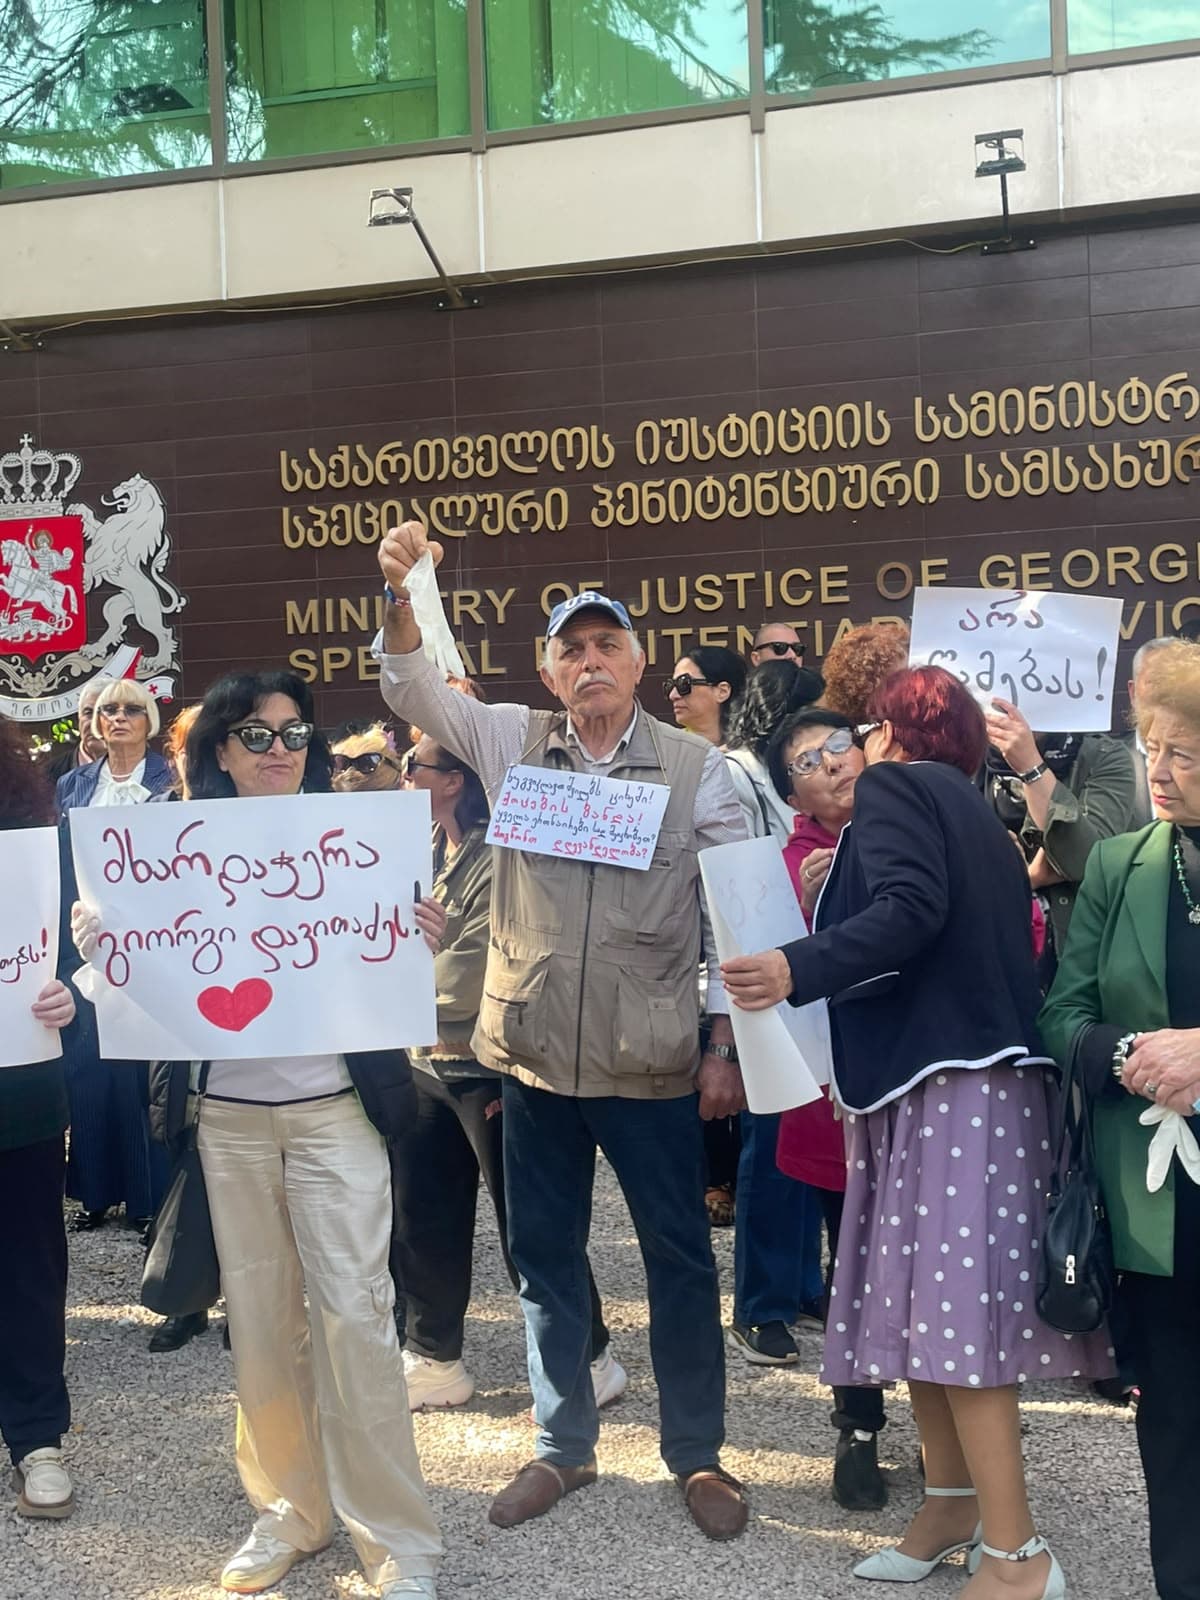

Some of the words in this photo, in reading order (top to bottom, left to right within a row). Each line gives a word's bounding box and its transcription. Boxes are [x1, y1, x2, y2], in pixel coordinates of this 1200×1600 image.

[280, 425, 615, 492] საქართველოს
[636, 401, 891, 465] იუსტიციის
[591, 457, 940, 529] პენიტენციური
[286, 588, 517, 635] MINIRY
[628, 565, 850, 617] JUSTICE
[876, 558, 949, 600] OF
[959, 590, 1044, 631] არა
[583, 800, 643, 826] ბანდა!
[98, 909, 236, 987] გიორგი
[250, 880, 421, 973] დავითაძეს!
